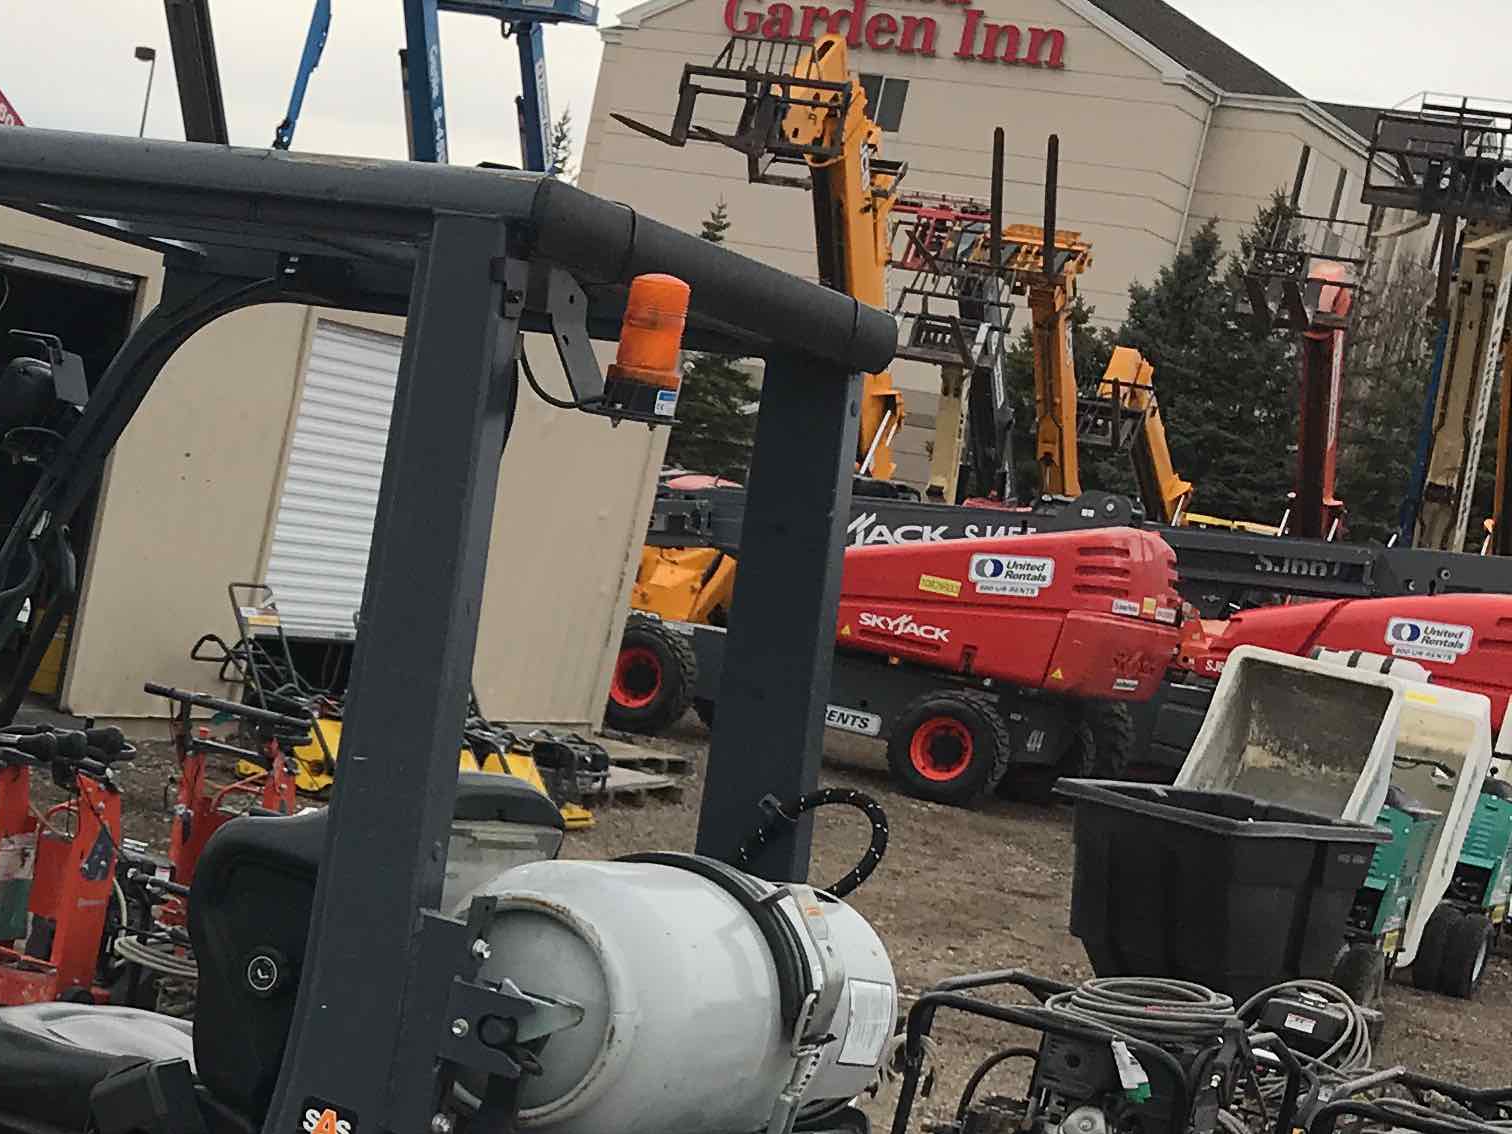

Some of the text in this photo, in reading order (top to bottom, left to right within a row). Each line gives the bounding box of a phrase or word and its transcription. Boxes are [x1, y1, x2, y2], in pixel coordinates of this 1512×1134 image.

[724, 0, 1067, 69] Garden Inn
[846, 512, 949, 549] JACK
[1006, 559, 1047, 572] United
[1003, 570, 1048, 583] Rentals
[858, 612, 951, 643] SKYJACK
[1424, 625, 1464, 639] United
[1421, 635, 1464, 649] Rentals
[825, 708, 870, 730] ENTS
